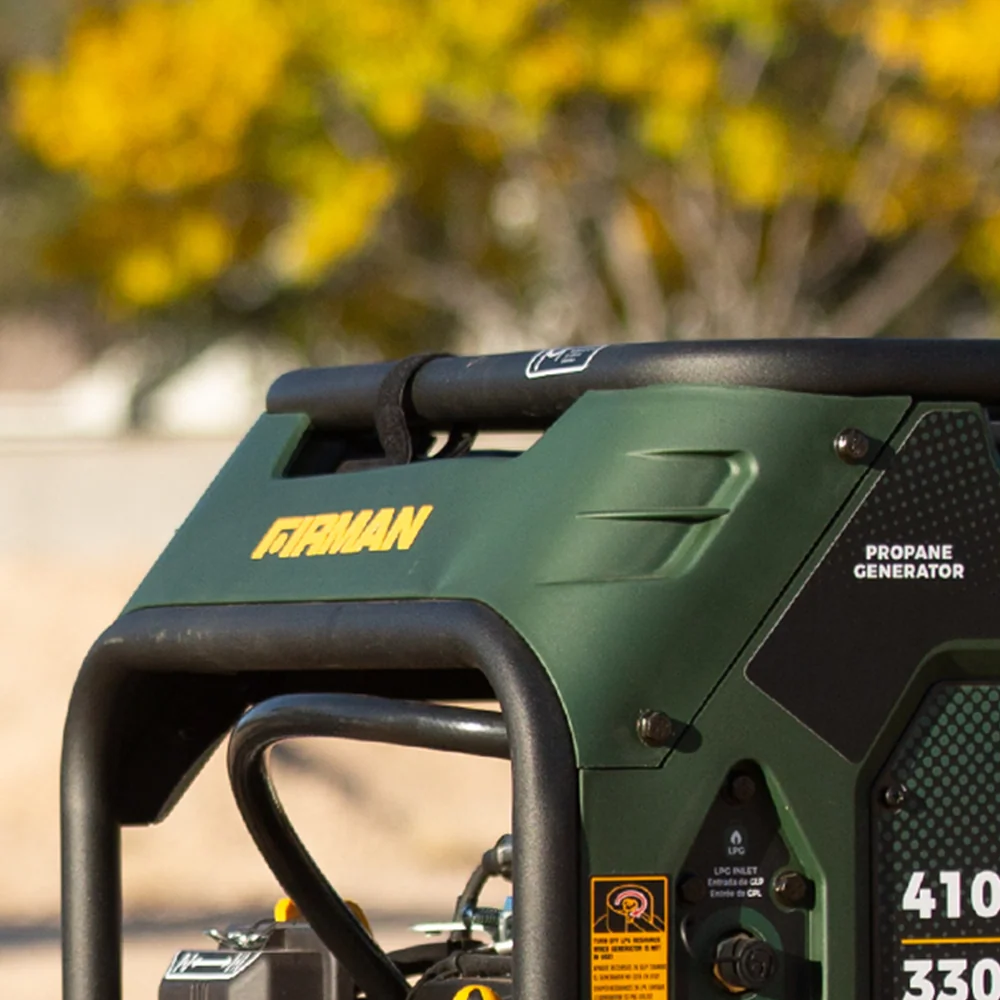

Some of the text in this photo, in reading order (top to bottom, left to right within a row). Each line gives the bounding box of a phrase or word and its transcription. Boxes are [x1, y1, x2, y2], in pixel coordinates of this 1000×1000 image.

[250, 504, 434, 560] FIRMAN
[865, 544, 953, 560] PROPANE
[853, 563, 965, 579] GENERATOR
[728, 846, 746, 856] LPG
[713, 866, 758, 876] LPG INLET
